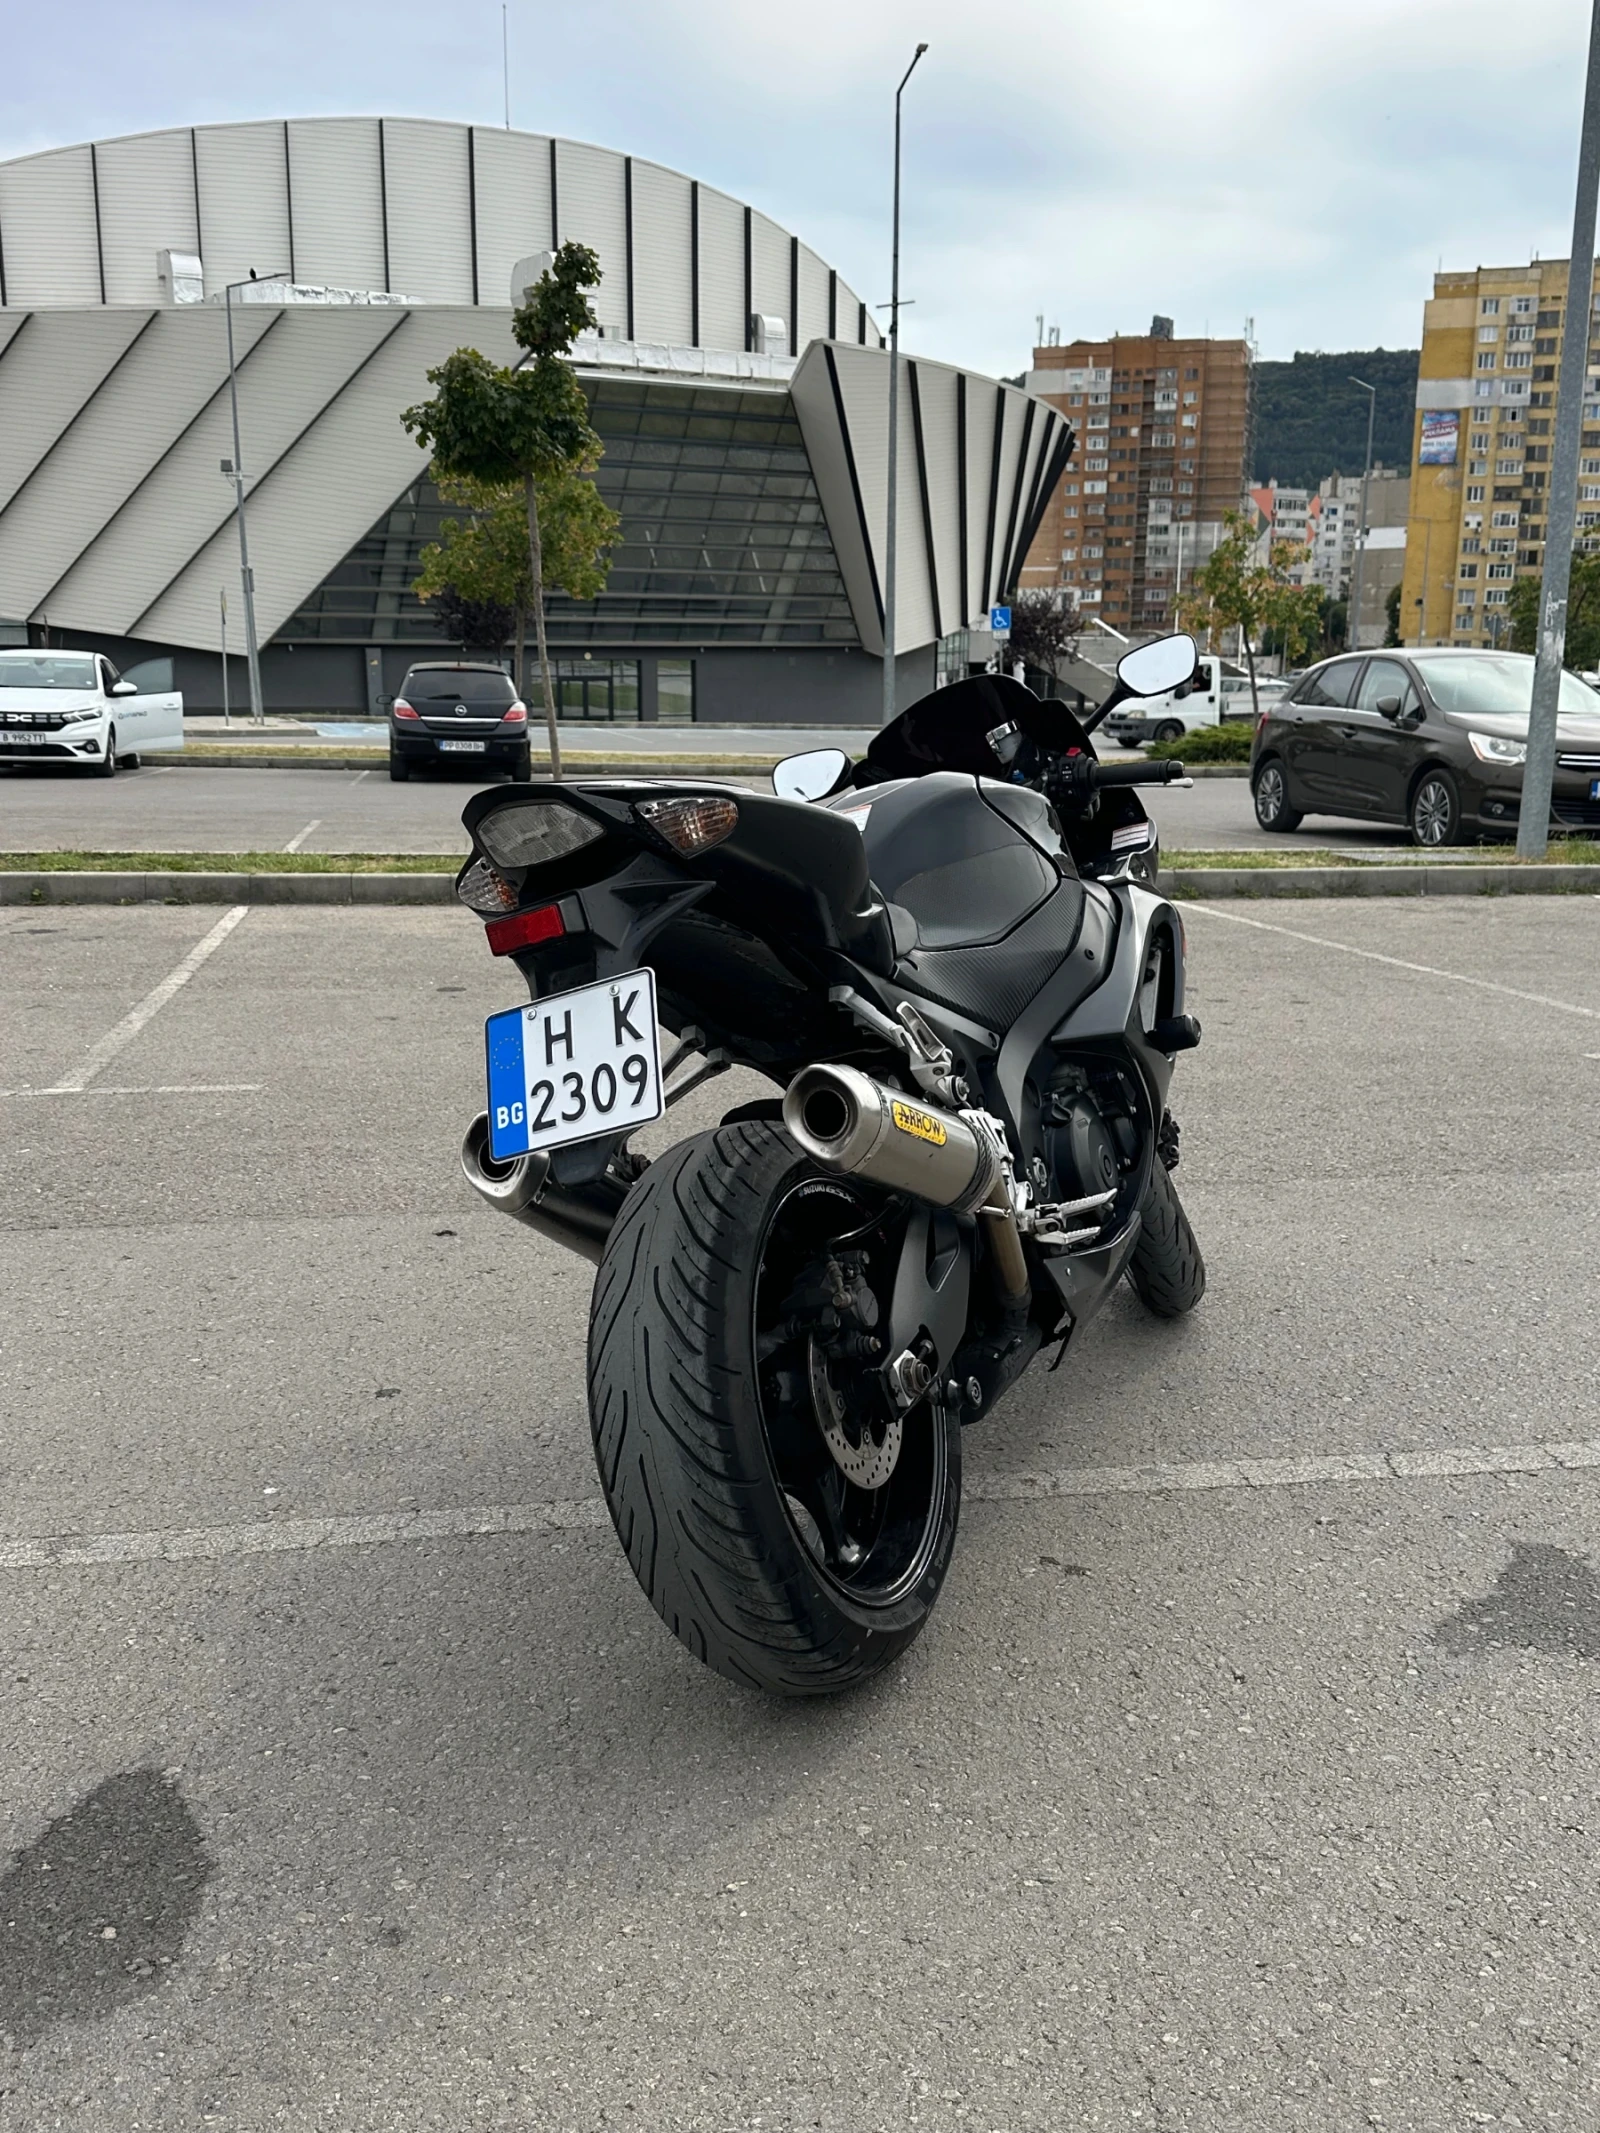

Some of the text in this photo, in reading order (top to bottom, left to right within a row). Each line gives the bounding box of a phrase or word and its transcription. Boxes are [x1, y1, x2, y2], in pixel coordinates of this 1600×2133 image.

[11, 732, 32, 742] 9952
[543, 989, 645, 1066] H K
[530, 1053, 649, 1134] 2309
[496, 1101, 525, 1130] BG
[898, 1104, 941, 1137] ARROW
[803, 1183, 825, 1196] SUZUKI
